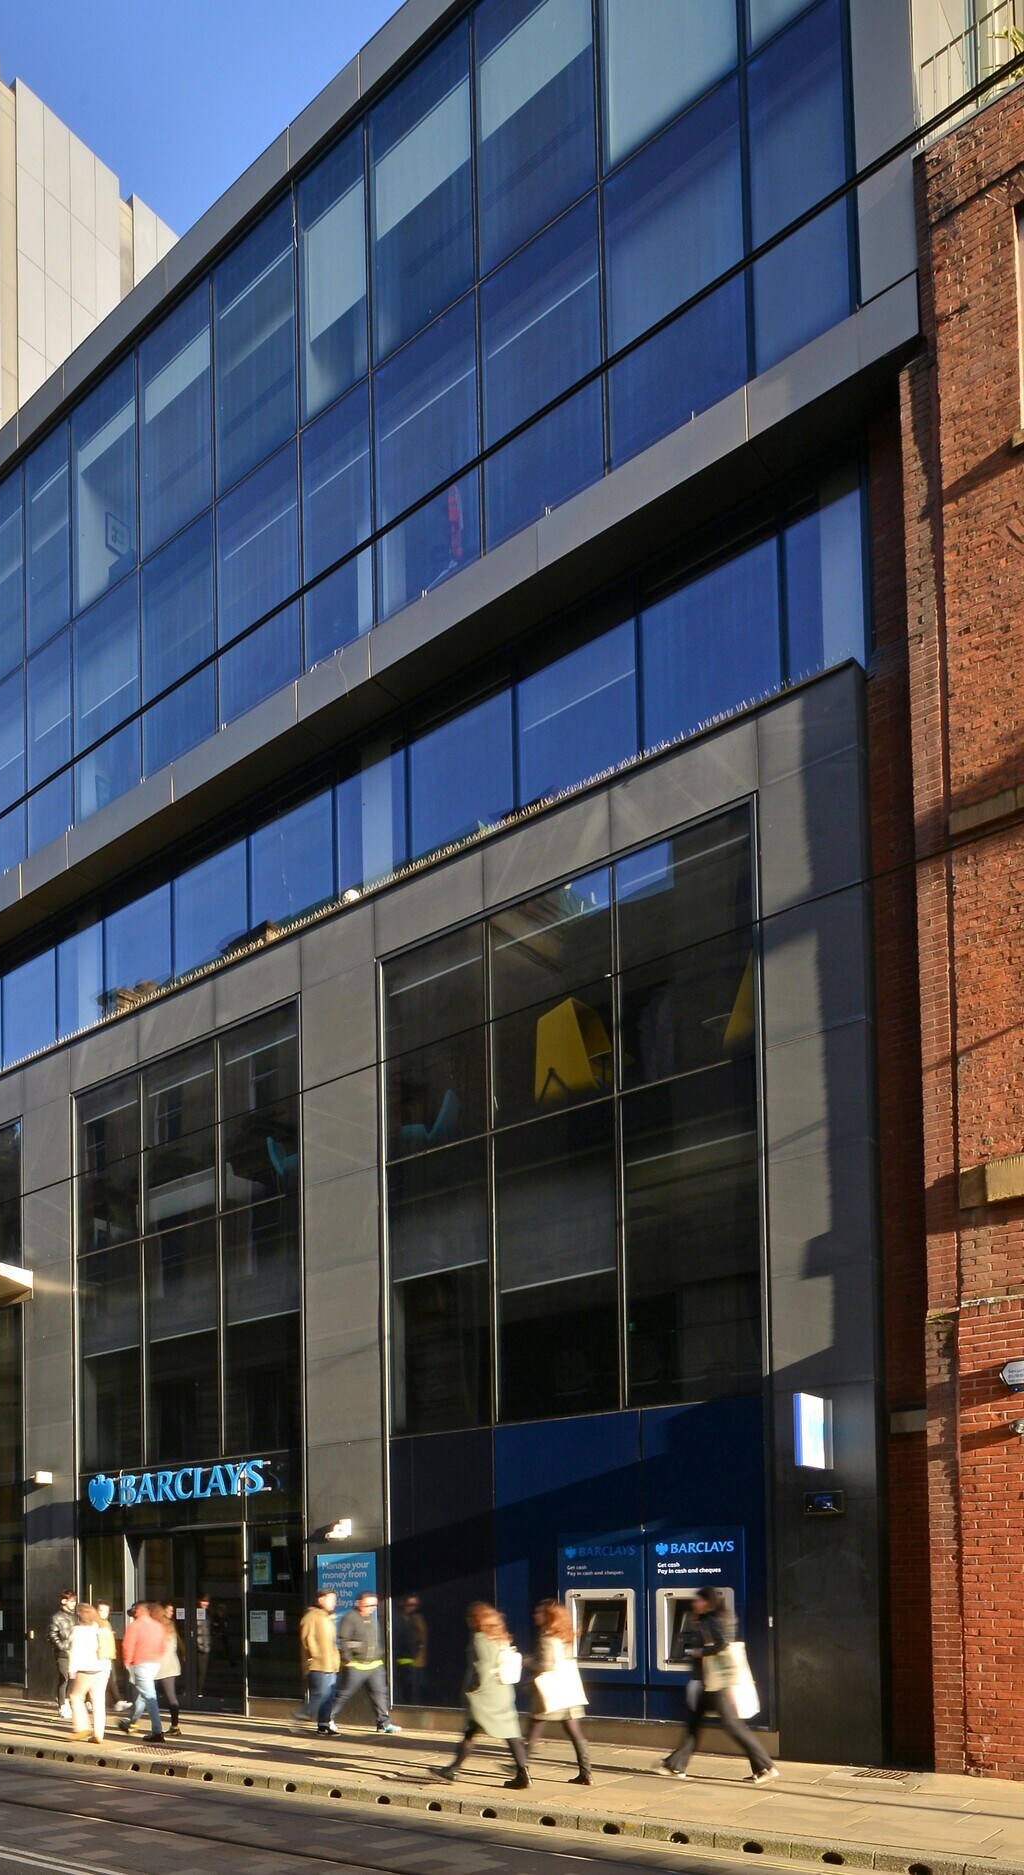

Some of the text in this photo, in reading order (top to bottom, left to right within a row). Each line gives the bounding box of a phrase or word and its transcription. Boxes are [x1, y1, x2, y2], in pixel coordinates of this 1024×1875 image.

[120, 1459, 264, 1505] BARCLAYS
[578, 1545, 636, 1557] BARCLAYS
[670, 1541, 734, 1554] BARCLAYS
[321, 1562, 369, 1571] Manage your
[348, 1570, 367, 1578] from
[322, 1581, 359, 1589] anywhere
